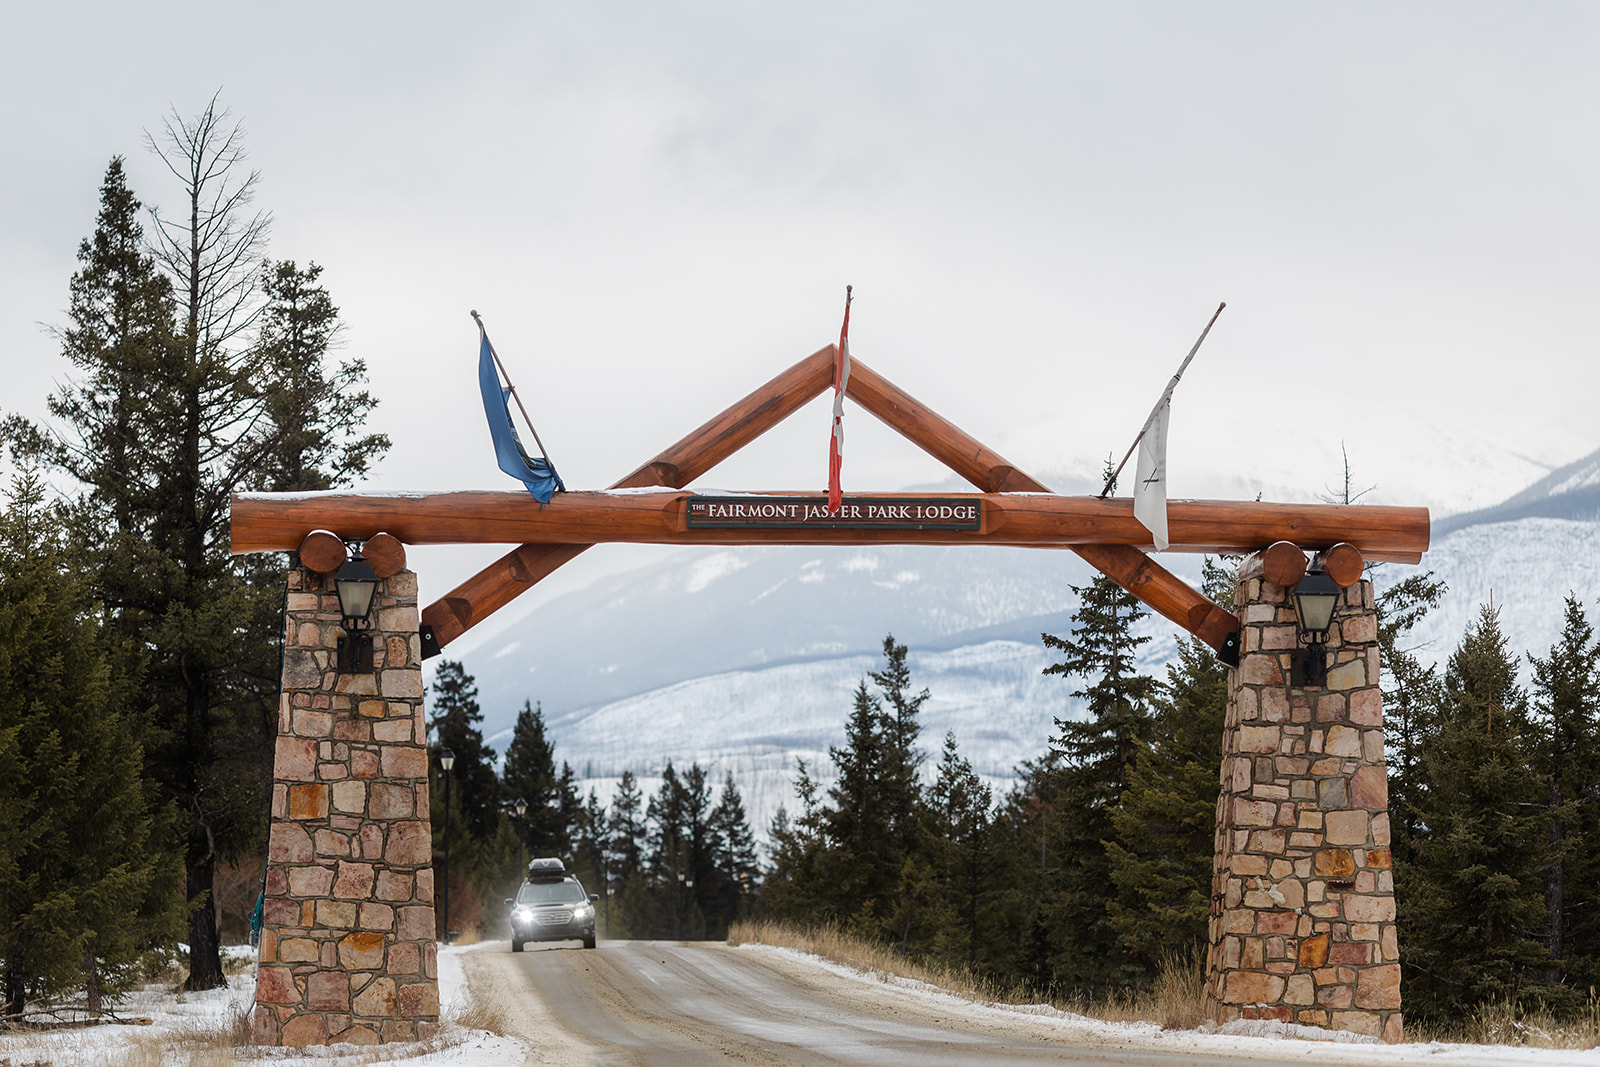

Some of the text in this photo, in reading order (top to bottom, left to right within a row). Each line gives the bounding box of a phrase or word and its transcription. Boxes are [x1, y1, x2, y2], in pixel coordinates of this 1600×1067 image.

[708, 504, 799, 518] FAIRMONT
[868, 505, 912, 519] PARK
[916, 505, 976, 519] LODGE
